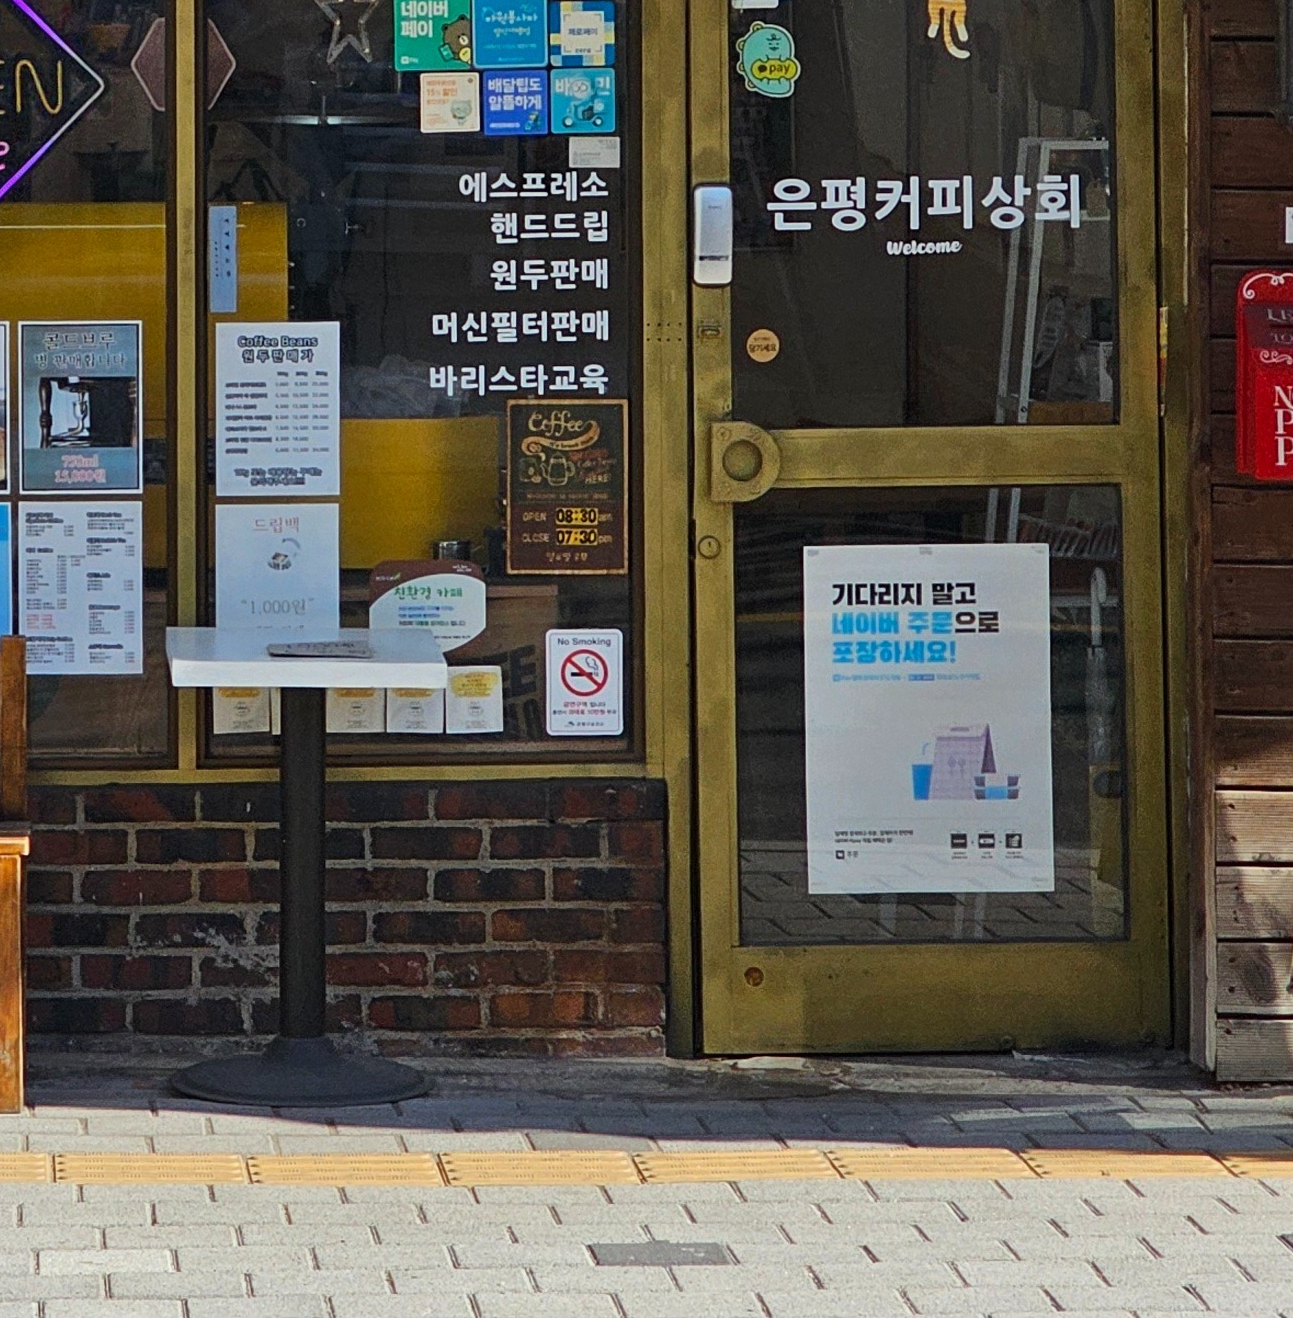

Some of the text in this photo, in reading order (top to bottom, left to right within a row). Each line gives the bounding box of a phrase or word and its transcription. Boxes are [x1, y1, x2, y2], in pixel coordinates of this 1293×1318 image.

[400, 0, 449, 19] 네이버
[400, 20, 434, 38] 페이
[768, 60, 791, 74] pay
[487, 77, 543, 93] 배달팁도
[488, 95, 543, 111] 알뜰하게
[458, 171, 609, 203] 에스프레소
[766, 174, 1081, 232] 은평커피상회
[490, 210, 609, 244] 핸드드립
[886, 239, 963, 256] Welcome
[490, 258, 609, 291] 원두판매
[432, 310, 609, 343] 머신필터판매
[43, 332, 117, 350] 콜드브루
[237, 335, 319, 348] Coffee Beans
[429, 363, 609, 396] 바리스타교육
[527, 410, 585, 437] Coffee
[253, 516, 301, 534] 드립백
[522, 511, 548, 522] OPEN
[557, 508, 597, 524] 08:30
[557, 529, 597, 545] 07:30
[393, 585, 464, 601] 친환경 카페
[832, 582, 977, 606] 기다리지 말고
[832, 611, 1000, 635] 네이버 주문으로
[557, 637, 612, 648] No Smoking
[832, 639, 957, 664] 포장하세요!
